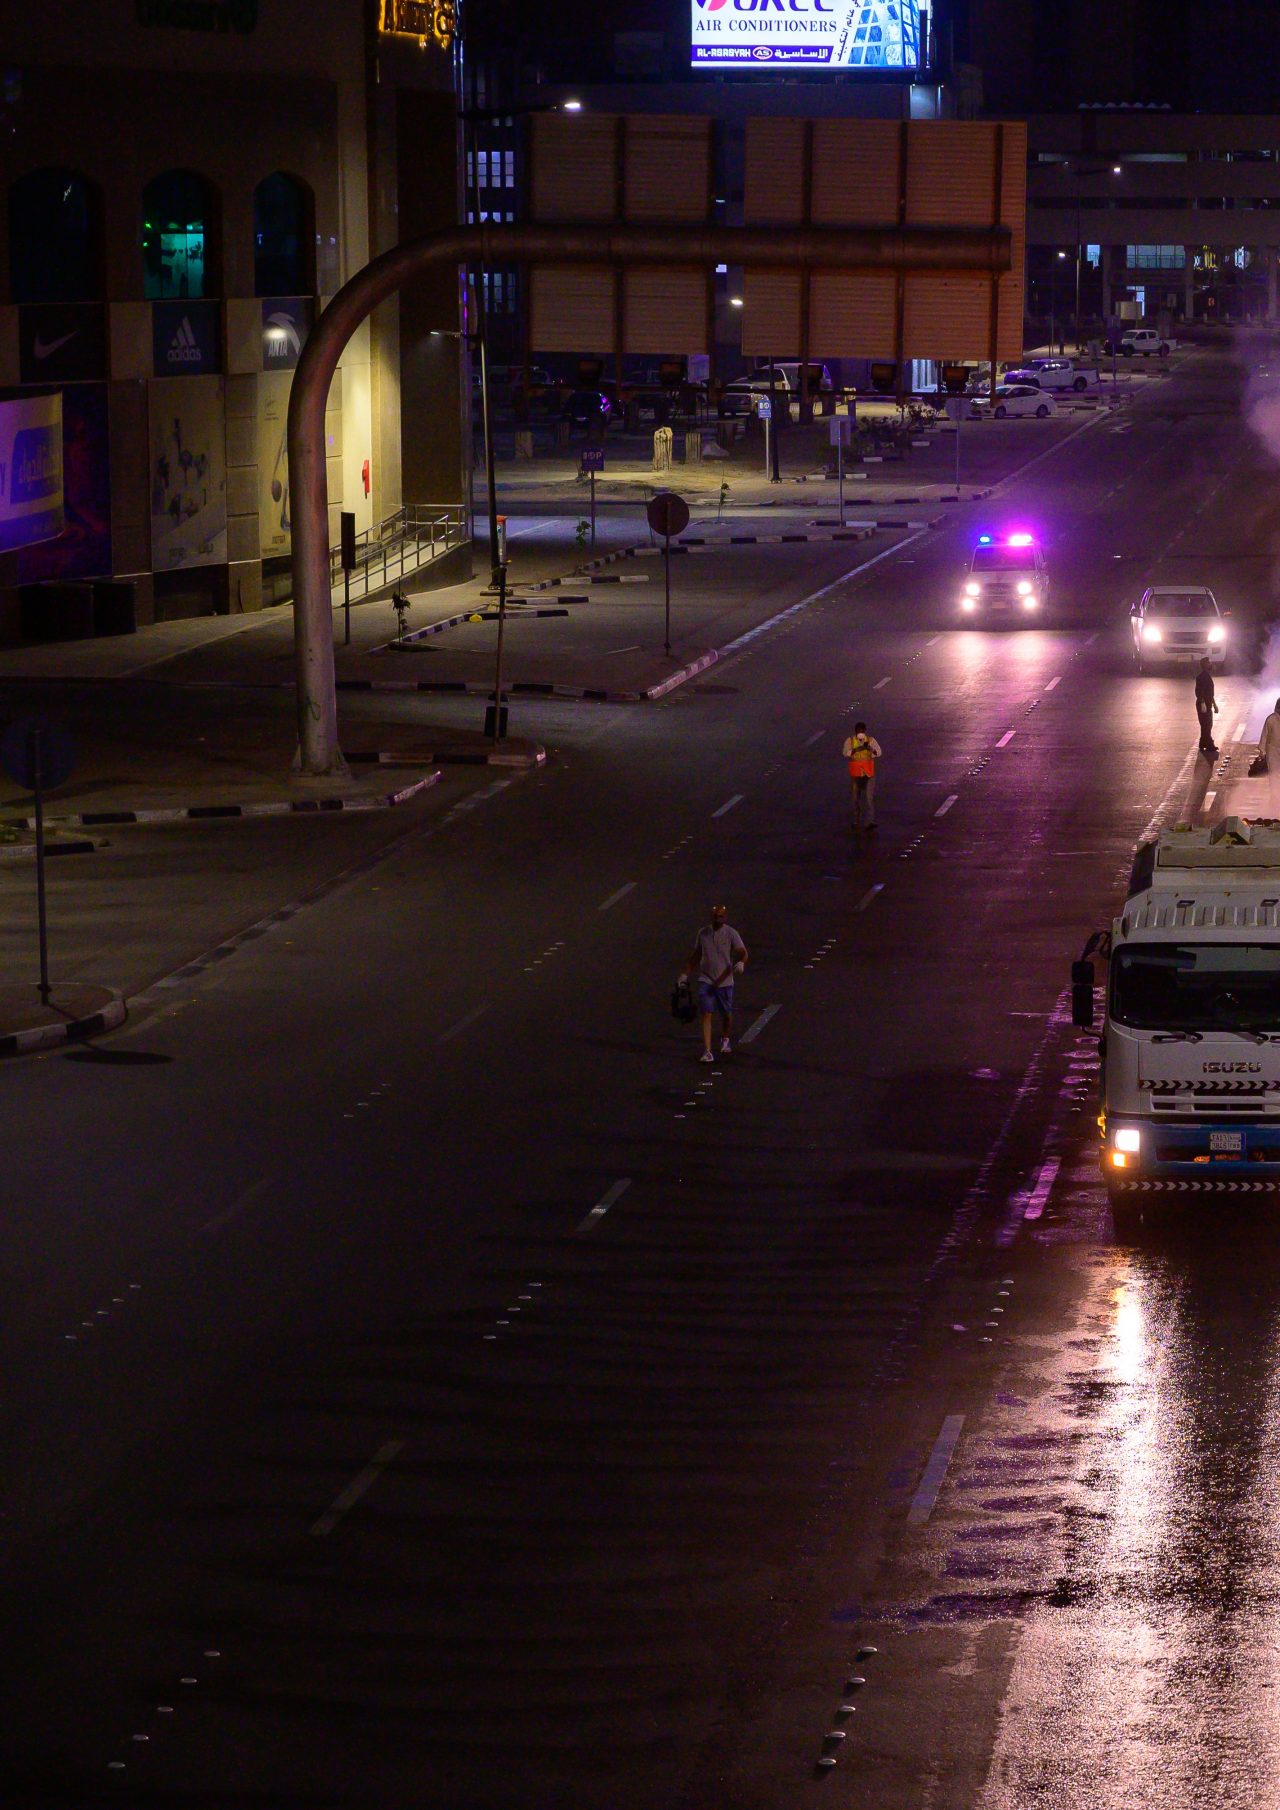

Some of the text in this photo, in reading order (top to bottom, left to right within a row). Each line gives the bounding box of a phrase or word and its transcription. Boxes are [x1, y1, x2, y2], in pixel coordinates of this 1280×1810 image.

[695, 19, 838, 32] AIR CONDITIONERS
[167, 347, 202, 362] adidas
[1202, 1062, 1262, 1073] ISUZU
